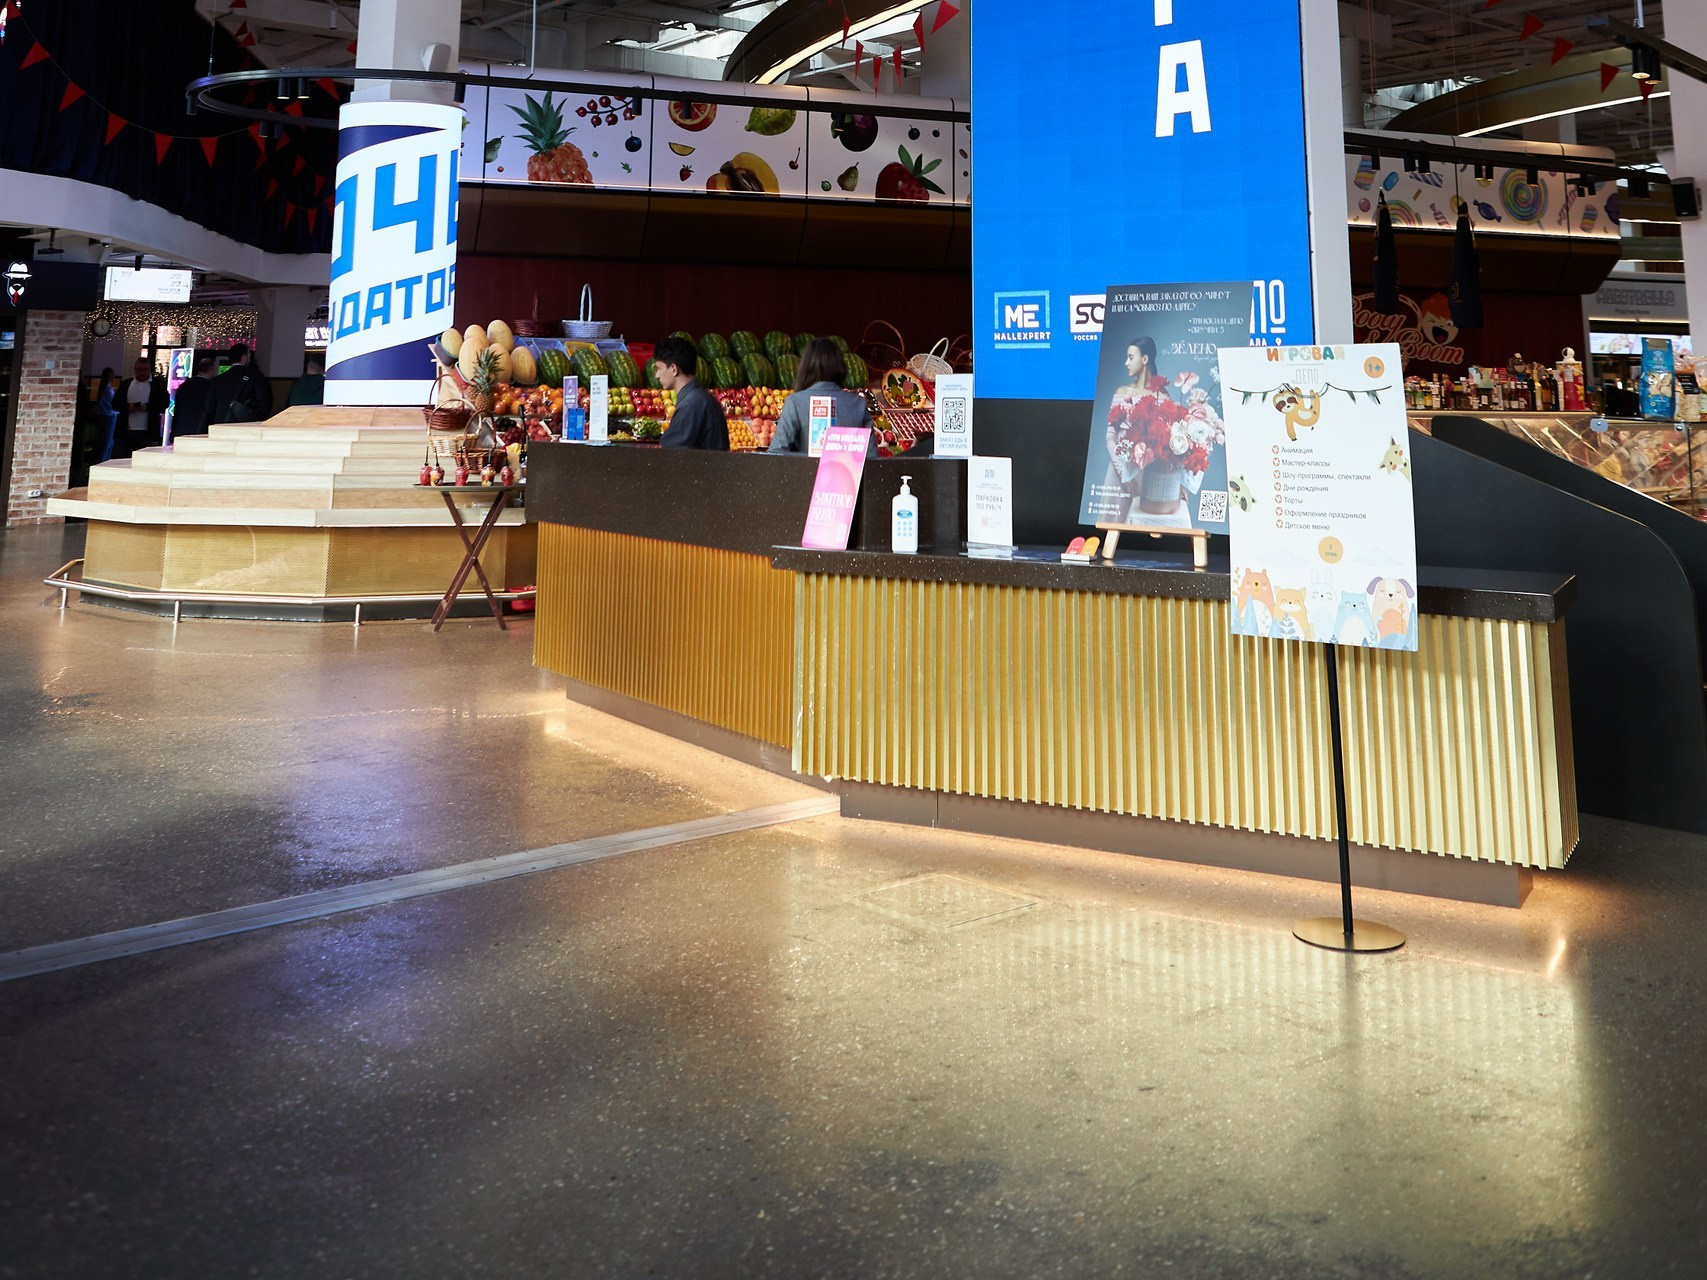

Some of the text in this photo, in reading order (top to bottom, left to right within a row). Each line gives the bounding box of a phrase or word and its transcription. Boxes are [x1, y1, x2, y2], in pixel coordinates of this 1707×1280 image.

[1113, 292, 1145, 302] ДОСТАВИМ
[1145, 292, 1159, 301] ВАШ
[1159, 292, 1180, 301] ЗАКАЗ
[1204, 290, 1231, 300] МИНУТ
[1005, 304, 1039, 329] ME
[994, 331, 1051, 341] MALLEXPERT
[1266, 346, 1345, 362] ИГРОВАЯ
[1281, 459, 1331, 467] Мастер-классы
[1282, 472, 1336, 480] Шоу-программы,
[1283, 484, 1296, 492] Дни
[975, 494, 1003, 503] ПАРКОВКА
[1284, 509, 1327, 518] Оформление
[1284, 522, 1310, 530] Детское
